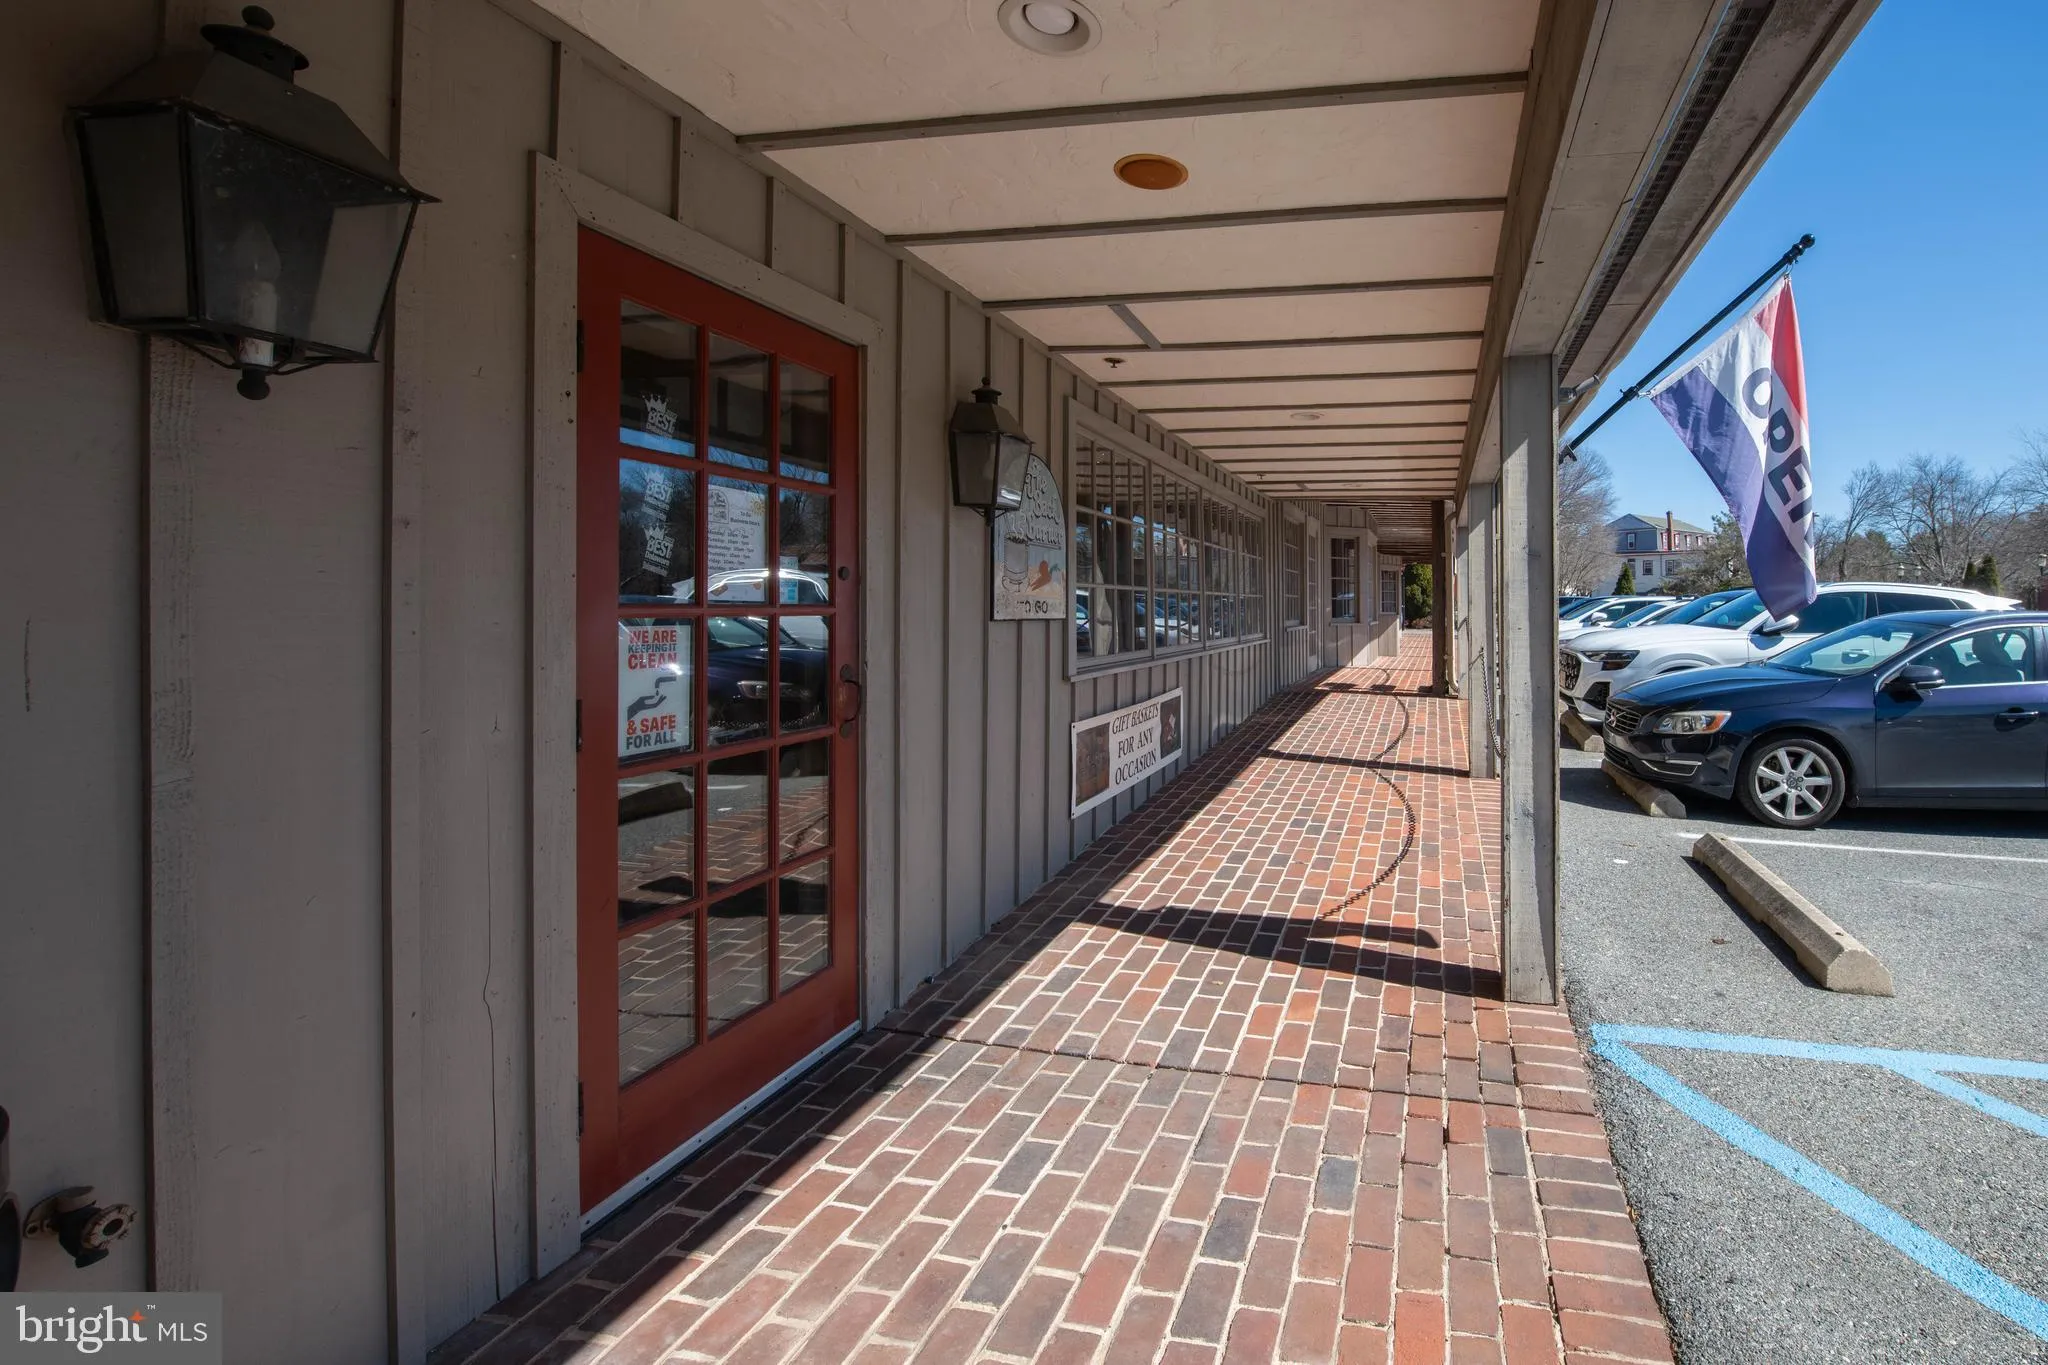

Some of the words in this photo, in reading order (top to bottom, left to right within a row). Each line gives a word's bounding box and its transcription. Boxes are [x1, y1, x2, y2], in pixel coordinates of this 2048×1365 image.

[648, 410, 676, 433] BEST
[646, 483, 673, 503] BEST
[647, 539, 673, 559] BEST
[629, 630, 650, 644] WE
[652, 630, 677, 643] ARE
[628, 643, 668, 653] KEEPING
[669, 643, 677, 652] IT
[628, 653, 677, 670] CLEAN
[626, 719, 637, 736] &
[640, 715, 676, 734] SAFE
[1112, 713, 1132, 734] GIFT
[1131, 702, 1160, 726] BASKETS
[626, 734, 651, 750] FOR
[654, 730, 677, 746] ALL
[1118, 735, 1134, 758] FOR
[1137, 726, 1154, 749] ANY
[1115, 748, 1157, 785] OCCASION
